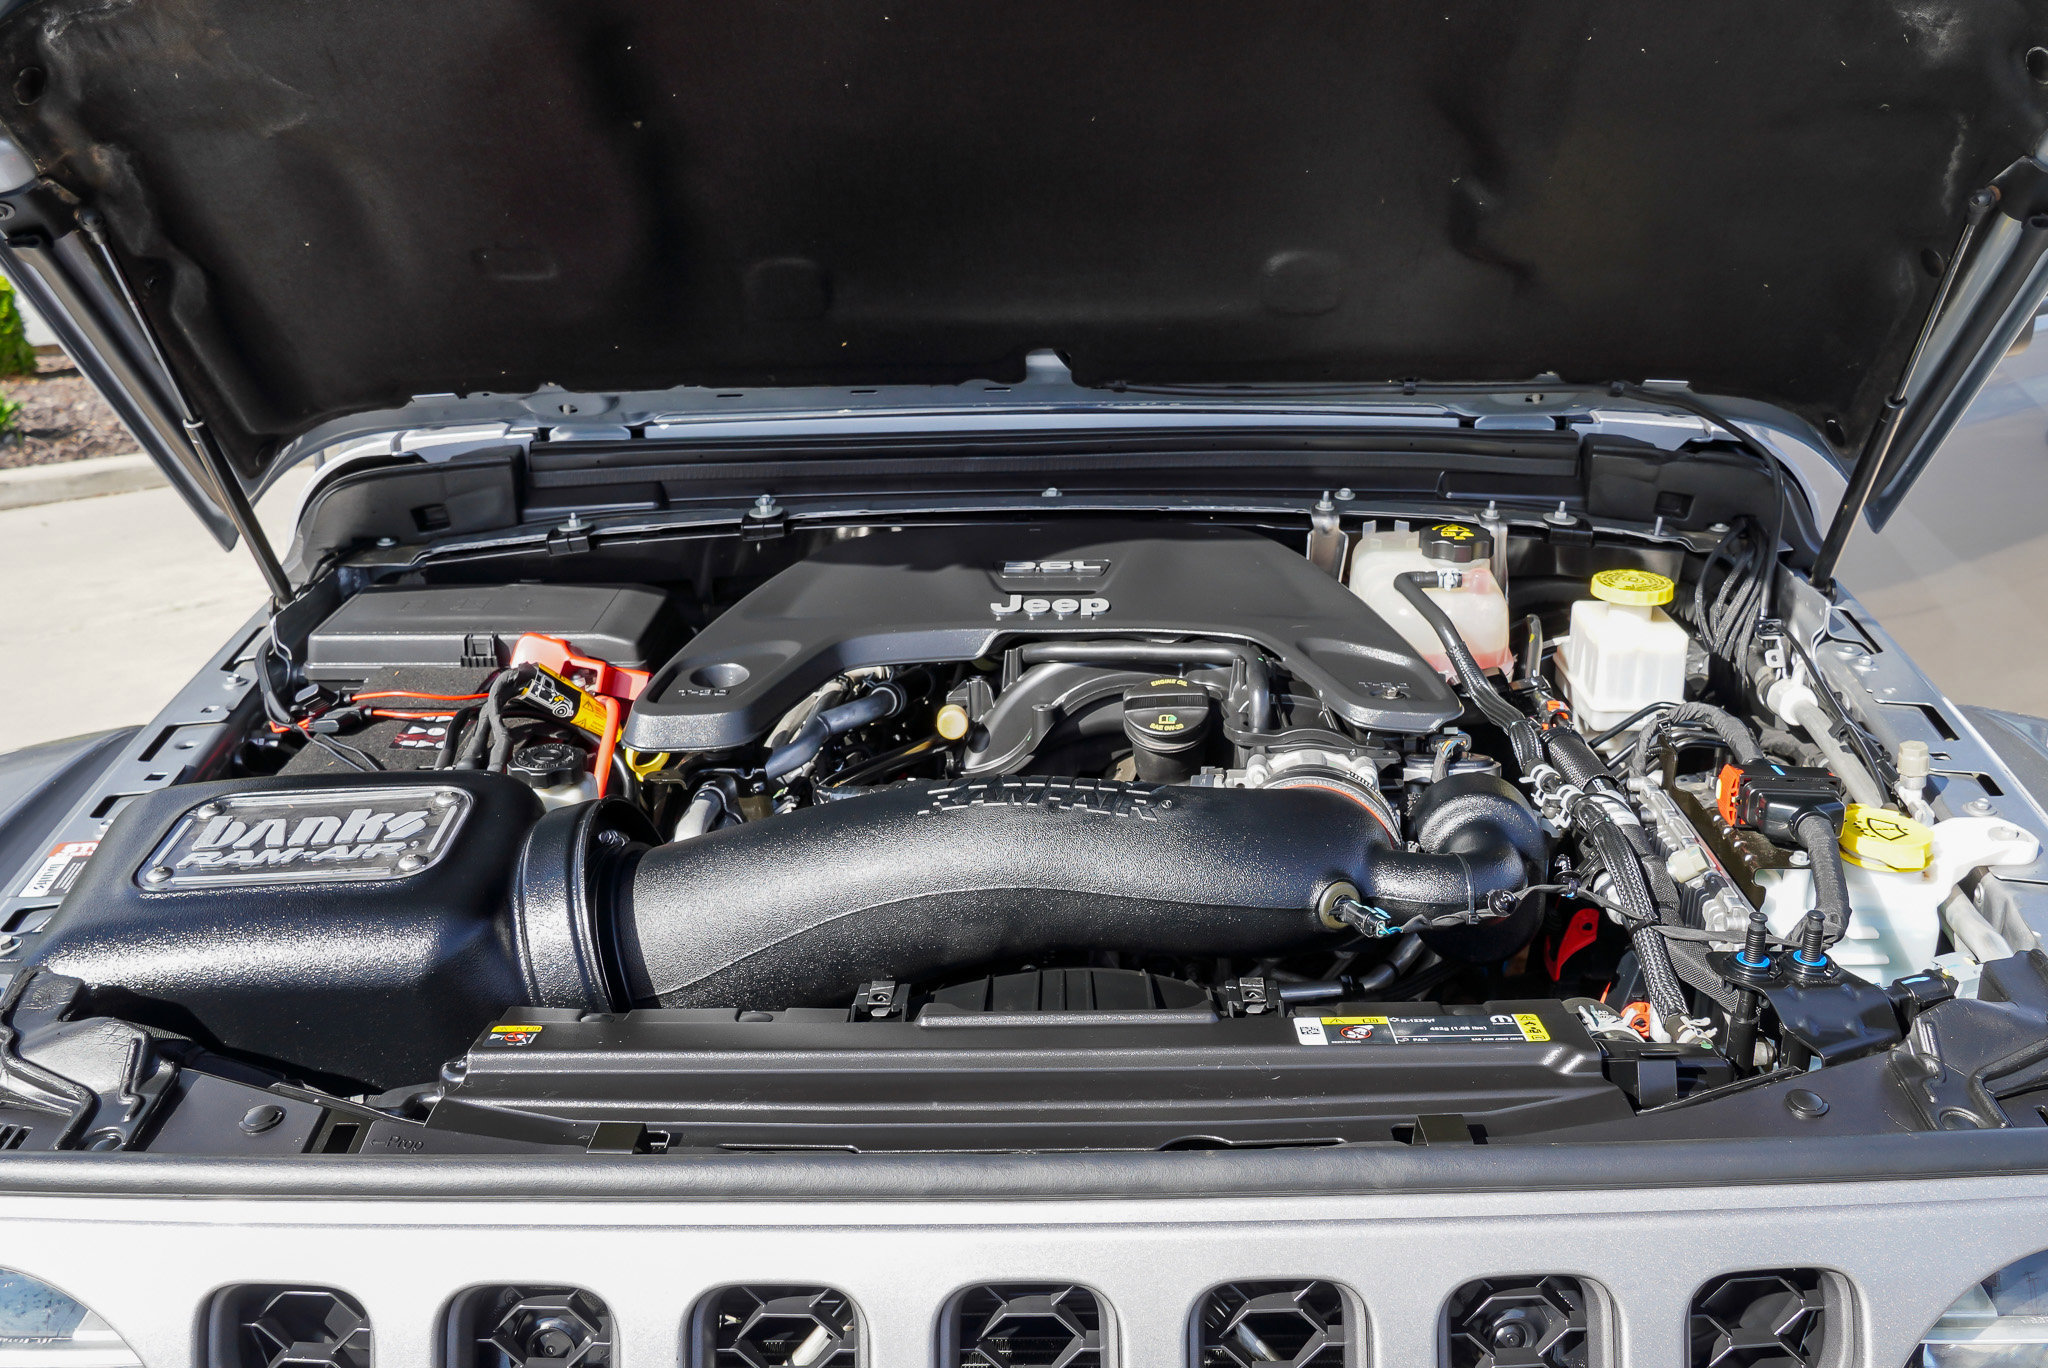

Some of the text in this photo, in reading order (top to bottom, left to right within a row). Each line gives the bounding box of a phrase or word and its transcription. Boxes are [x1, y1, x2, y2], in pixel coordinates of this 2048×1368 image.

[990, 594, 1110, 617] Jeep
[1151, 679, 1188, 687] ENGINE OIL
[192, 808, 429, 850] banks
[386, 1135, 424, 1153] Prop
